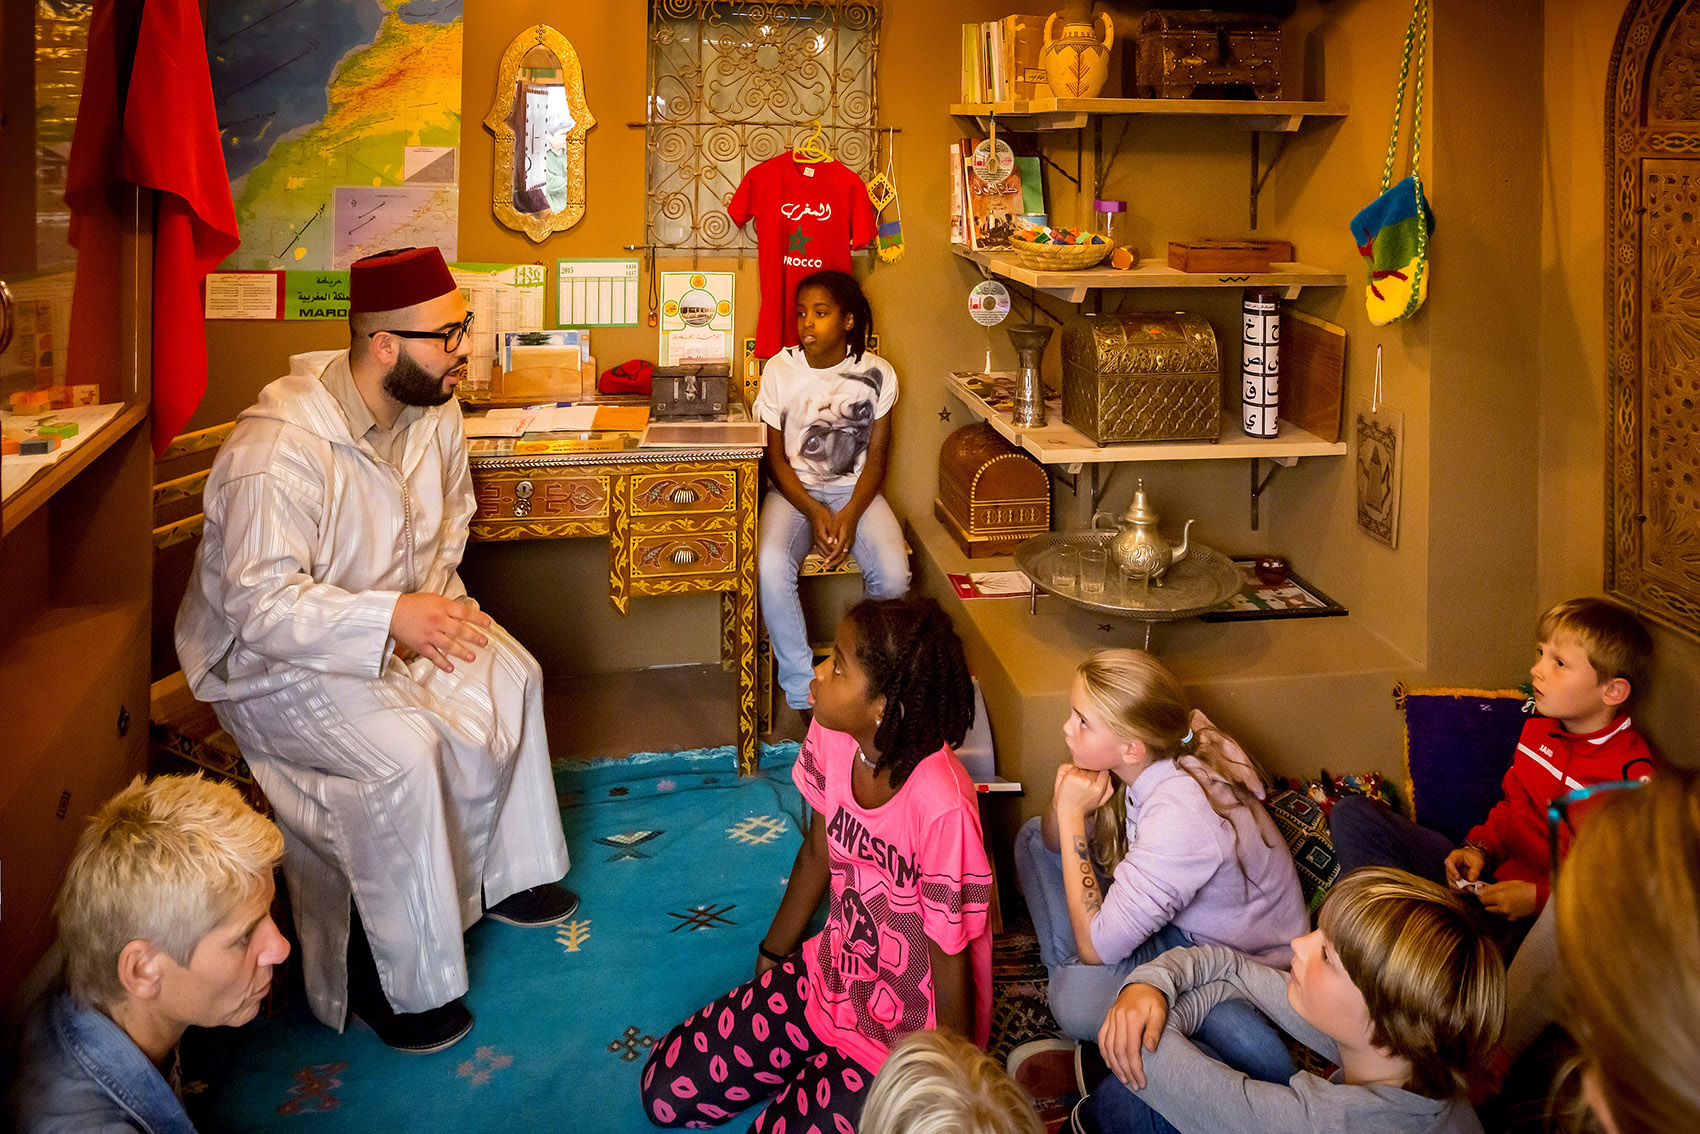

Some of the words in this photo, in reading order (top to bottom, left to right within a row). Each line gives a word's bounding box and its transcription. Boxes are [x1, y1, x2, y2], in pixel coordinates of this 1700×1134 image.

[781, 203, 831, 222] المغرب
[784, 255, 822, 269] ROCCO
[514, 266, 541, 277] 1436
[297, 291, 331, 303] المغربية
[300, 308, 350, 318] MARO
